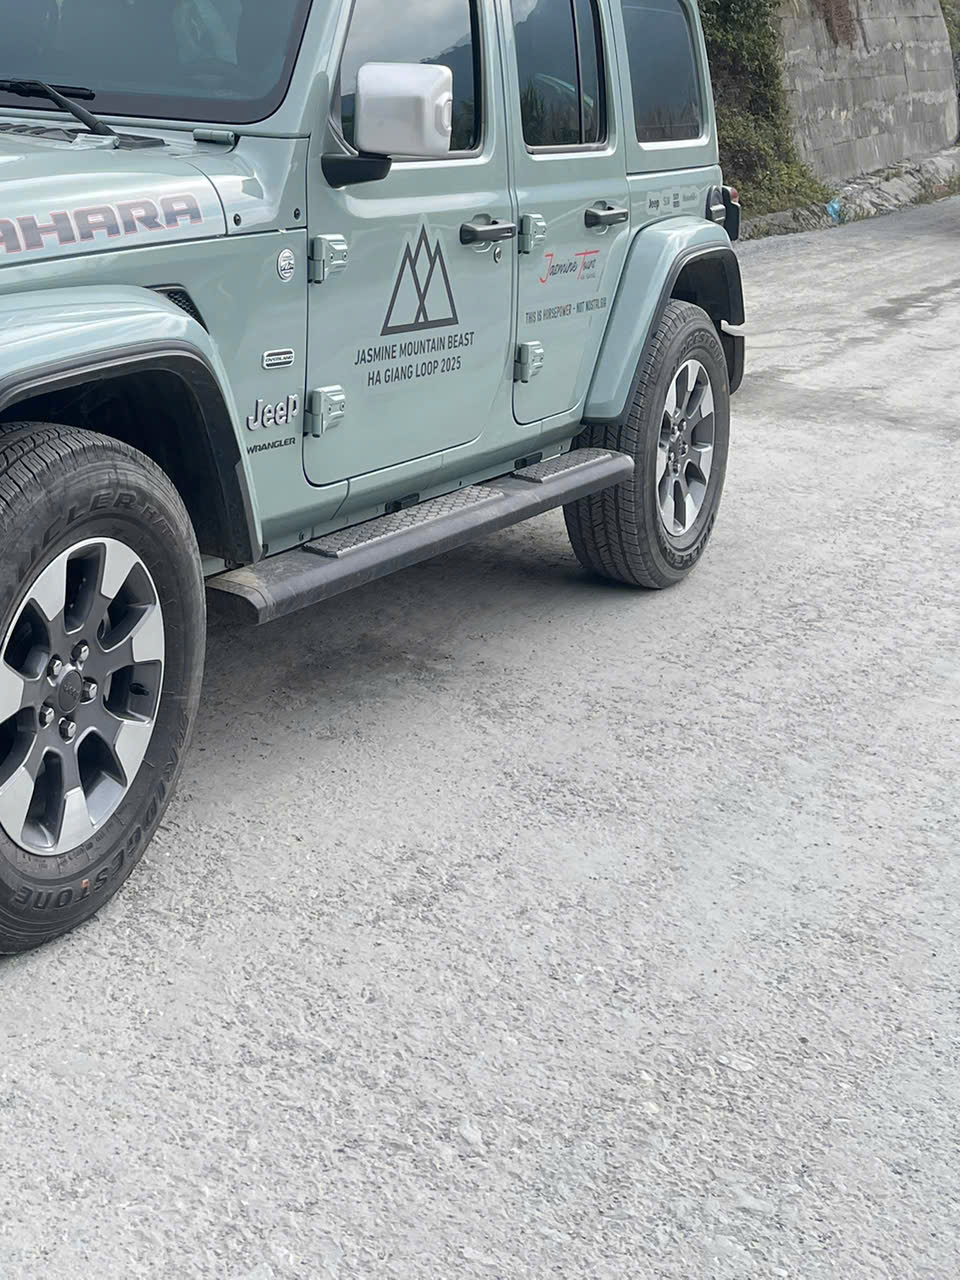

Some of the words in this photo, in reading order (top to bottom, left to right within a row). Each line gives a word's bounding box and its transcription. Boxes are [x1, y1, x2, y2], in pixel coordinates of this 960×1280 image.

[354, 344, 397, 366] JASMINE
[399, 337, 446, 359] MOUNTAIN
[447, 331, 475, 350] BEAST
[367, 370, 382, 387] HA
[384, 364, 413, 384] GIANG
[415, 359, 439, 378] LOOP
[441, 355, 461, 373] 2025
[246, 393, 300, 432] Jeep
[246, 437, 296, 455] WRANGLER
